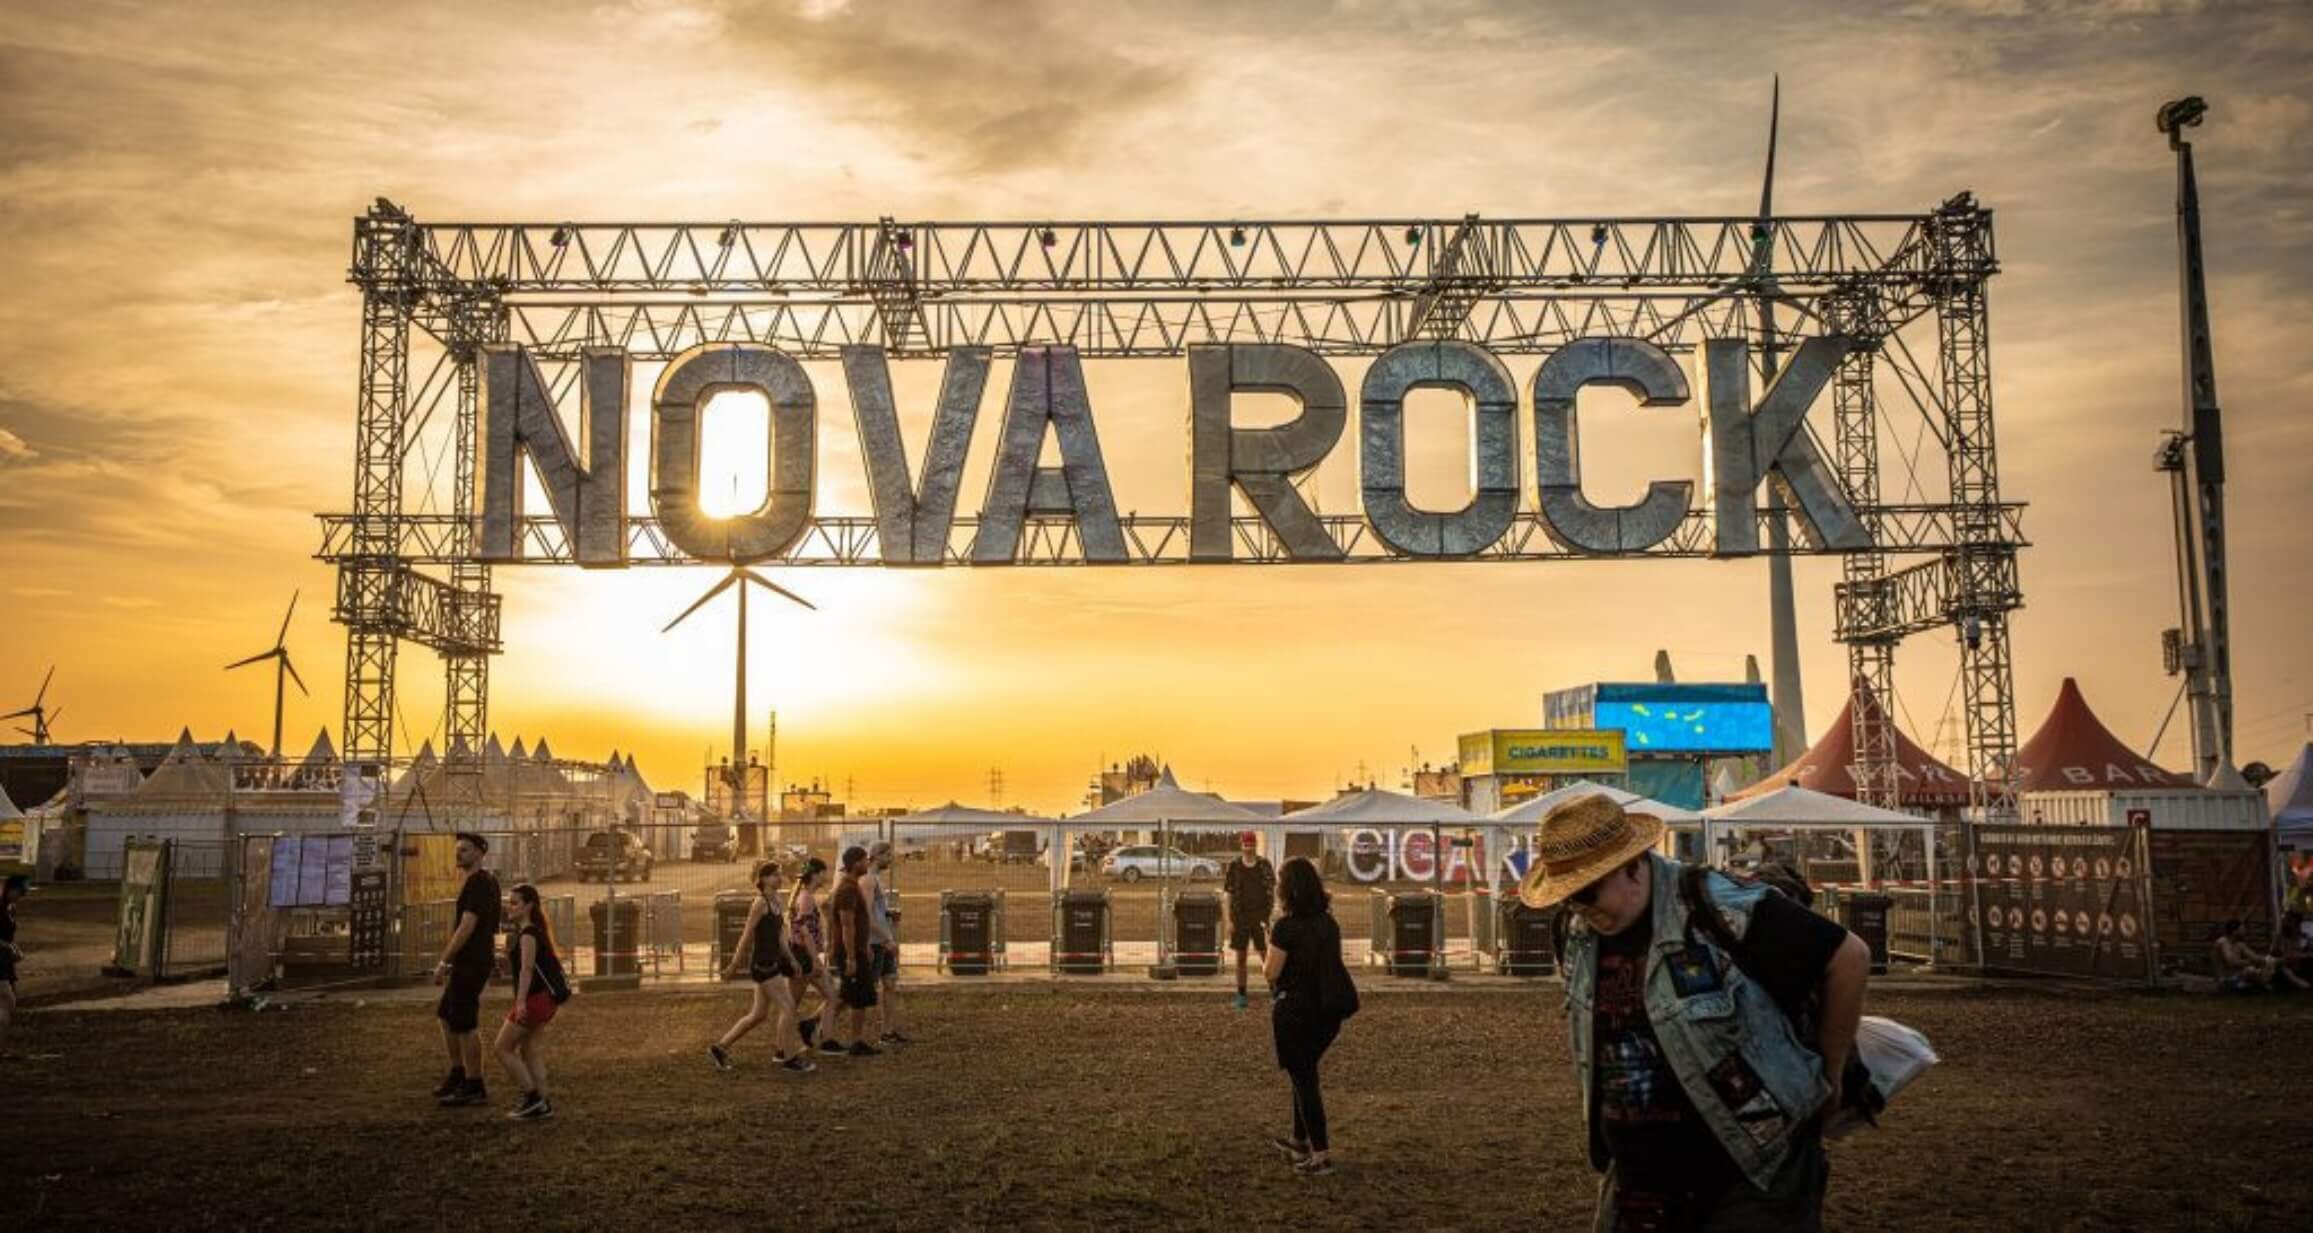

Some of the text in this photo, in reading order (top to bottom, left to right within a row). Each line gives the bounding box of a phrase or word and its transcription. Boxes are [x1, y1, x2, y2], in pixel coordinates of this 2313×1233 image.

[477, 336, 1876, 568] NOVA ROCK
[1508, 745, 1609, 760] CIGARETTES
[2061, 763, 2168, 784] BAR
